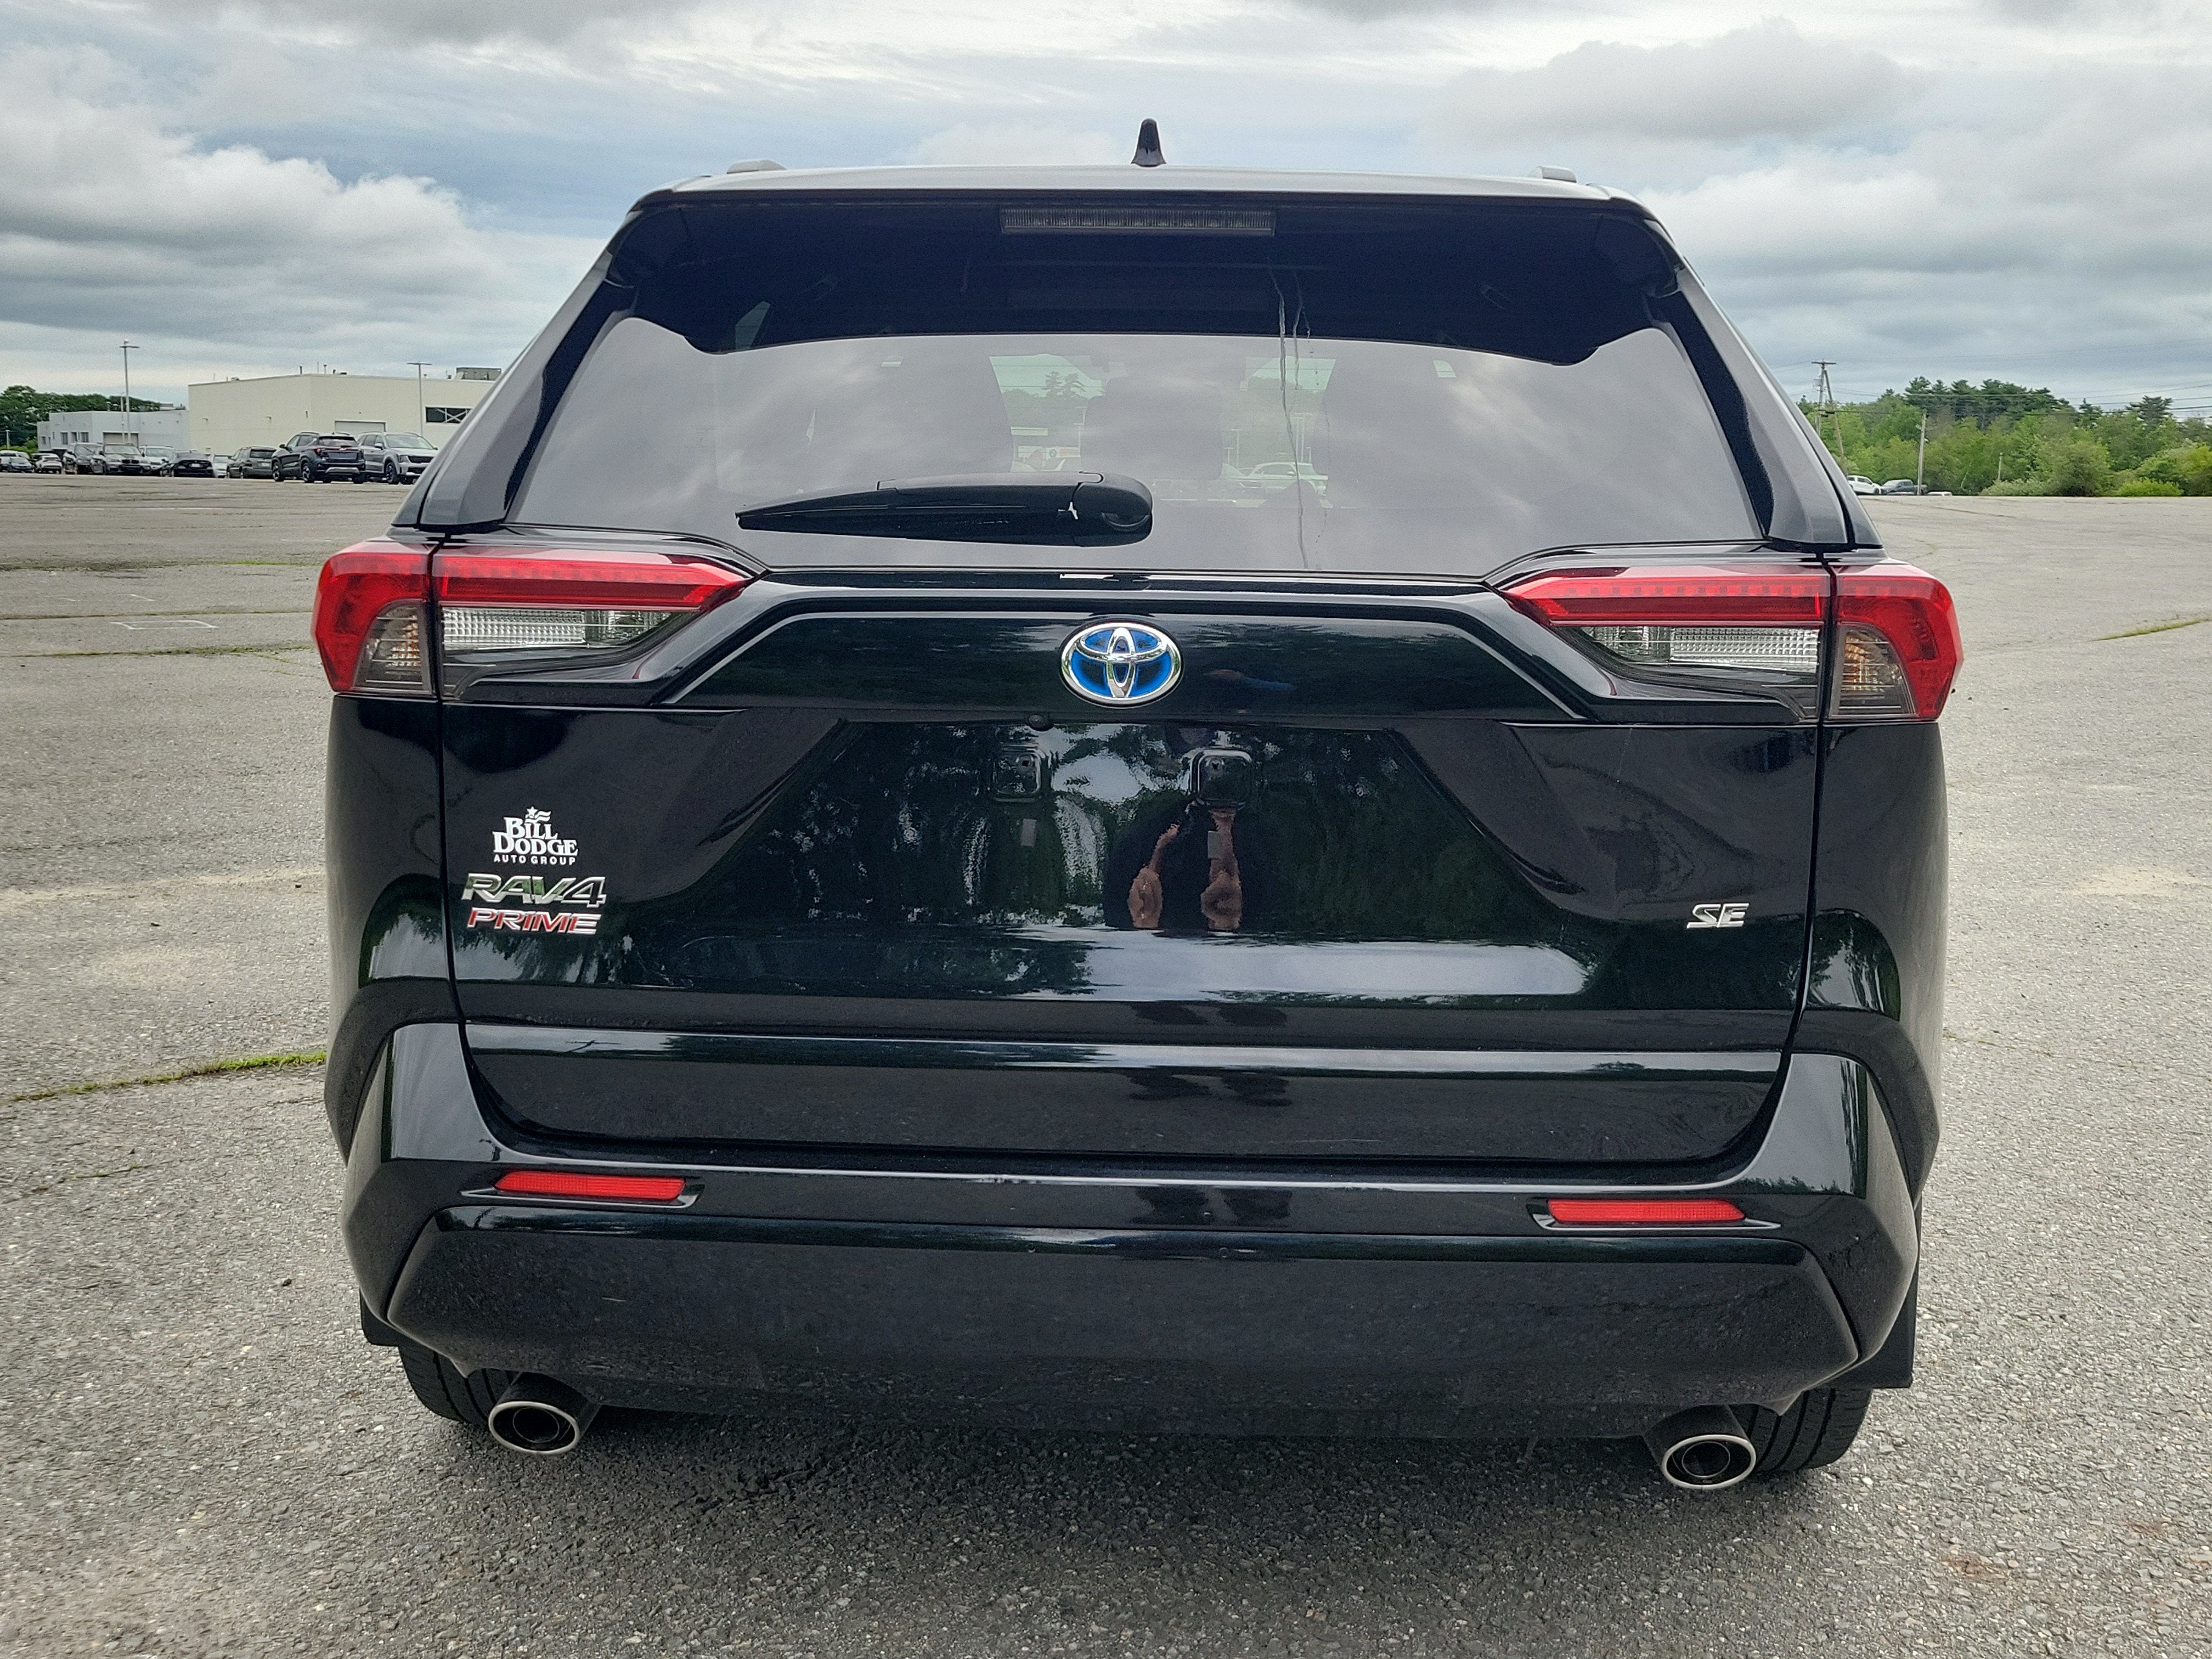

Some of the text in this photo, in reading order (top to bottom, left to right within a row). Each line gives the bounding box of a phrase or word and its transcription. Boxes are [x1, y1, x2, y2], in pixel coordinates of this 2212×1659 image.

[504, 817, 558, 840] BILL
[493, 832, 578, 856] DODGE
[494, 854, 575, 866] AUTO GROUP
[461, 873, 607, 908] RAV4
[467, 907, 602, 935] PRIME
[1686, 902, 1750, 929] SE
